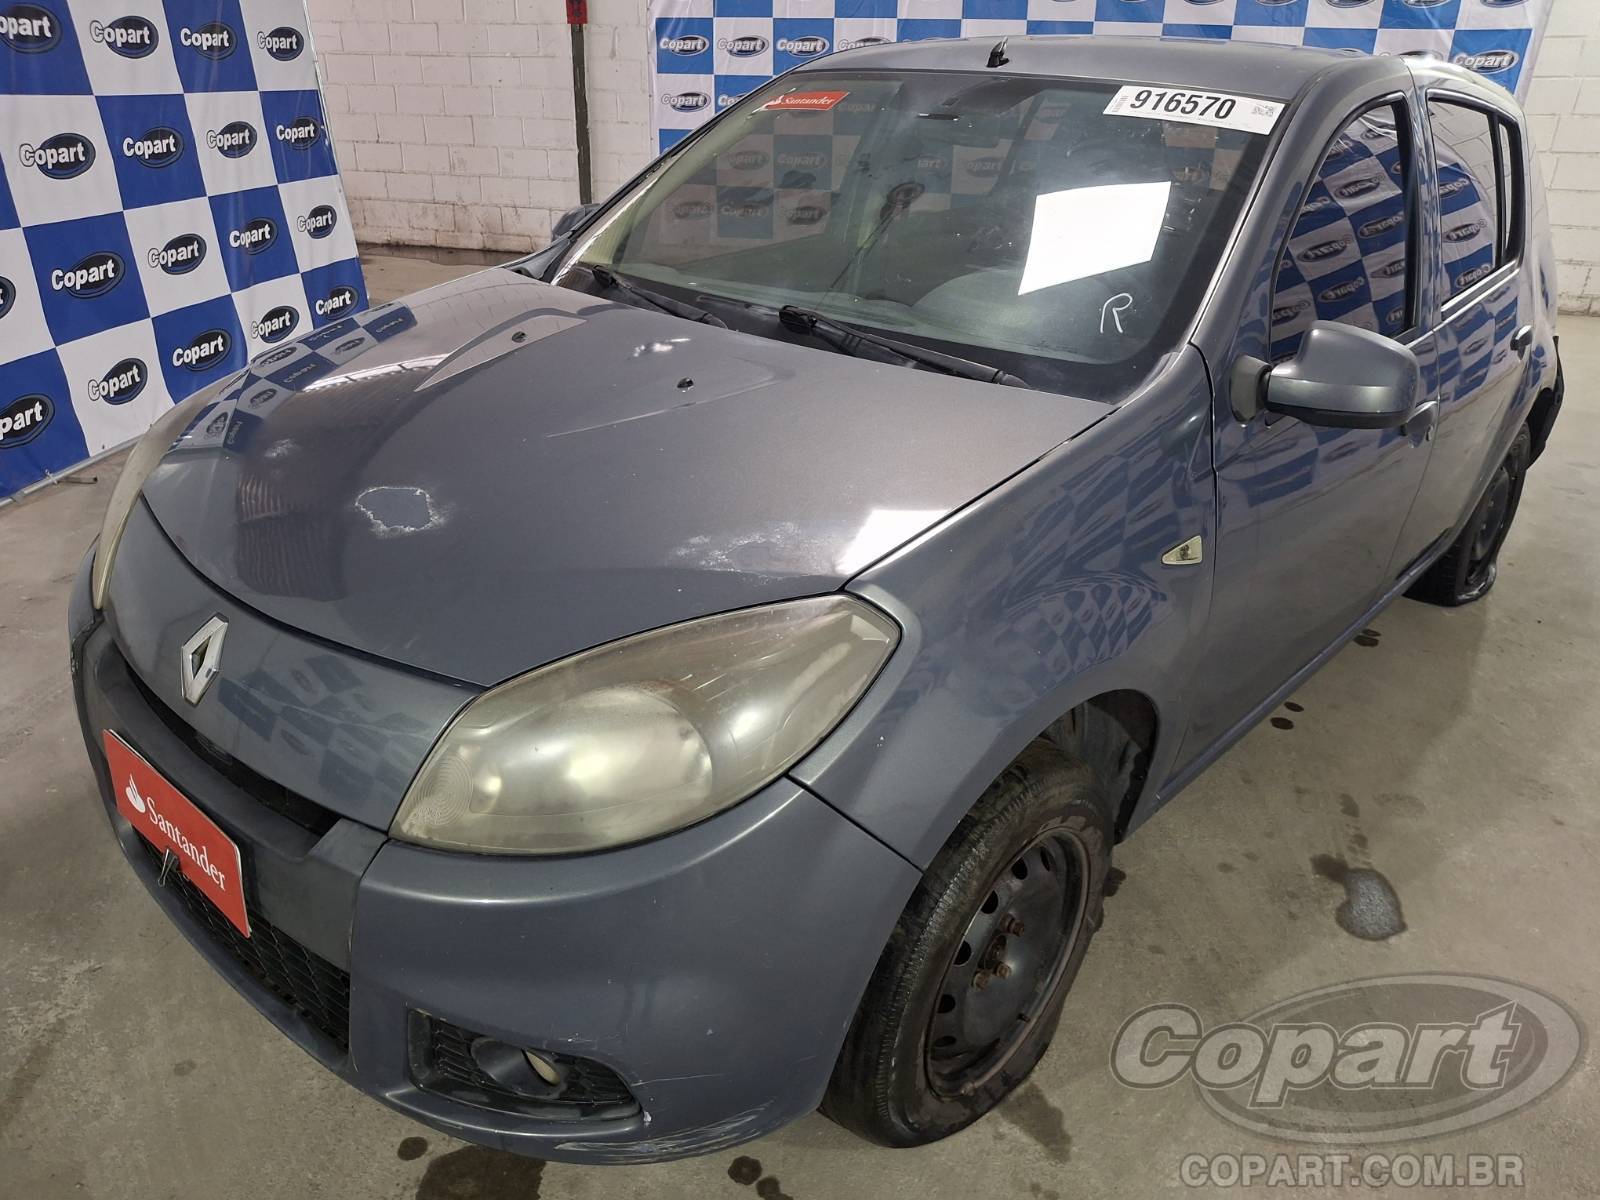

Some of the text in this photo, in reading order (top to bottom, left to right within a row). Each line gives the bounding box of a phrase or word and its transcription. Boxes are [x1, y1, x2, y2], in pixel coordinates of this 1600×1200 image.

[0, 15, 52, 40] opart
[90, 20, 151, 47] Copart
[180, 28, 230, 50] Copart
[257, 32, 298, 51] Copart
[660, 38, 705, 53] Copart
[717, 38, 762, 54] Copart
[776, 38, 824, 54] Copart
[1453, 52, 1511, 70] Copart
[661, 93, 705, 108] Copart
[785, 96, 834, 105] Santander
[1130, 89, 1237, 120] 916570
[206, 127, 251, 151] Copart
[276, 122, 316, 143] Copart
[19, 142, 86, 169] Copart
[123, 133, 176, 159] Copart
[229, 222, 271, 248] Copart
[297, 213, 333, 234] Copart
[148, 240, 200, 267] Copart
[51, 259, 116, 291] Copart
[315, 289, 352, 317] Copart
[1100, 292, 1133, 333] R
[251, 310, 292, 338] Copart
[172, 337, 225, 367] Copart
[88, 365, 141, 402] Copart
[0, 401, 43, 440] part
[146, 796, 226, 892] Santander
